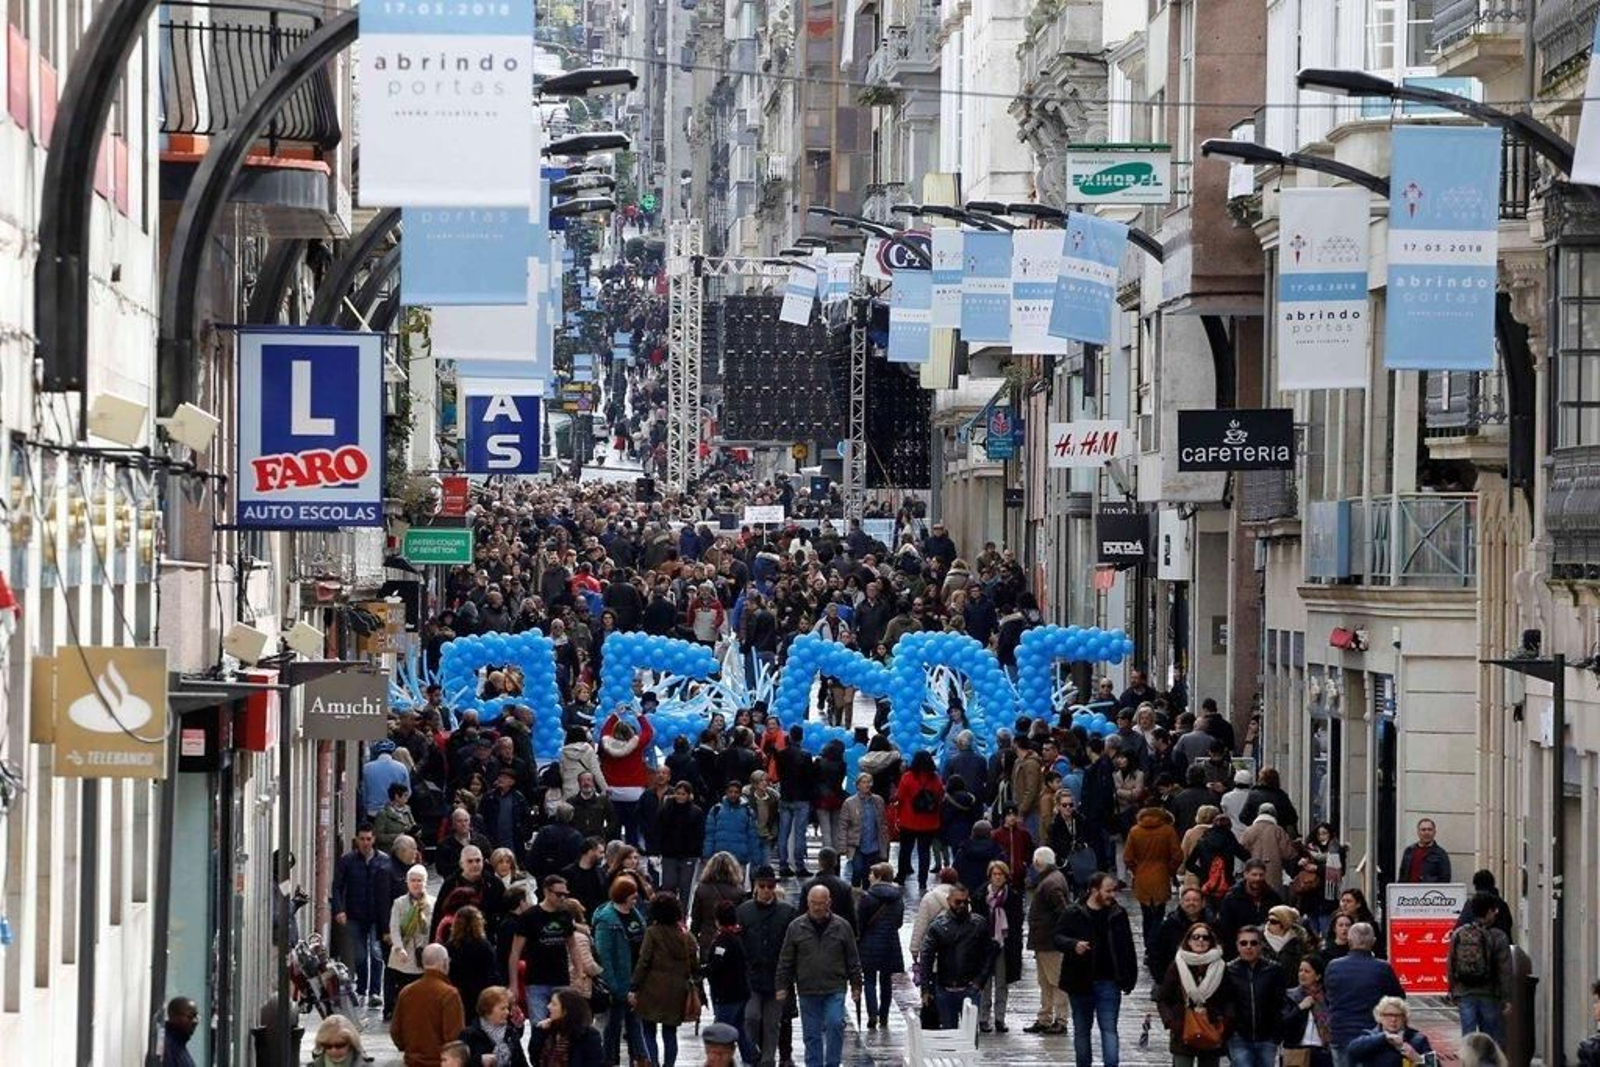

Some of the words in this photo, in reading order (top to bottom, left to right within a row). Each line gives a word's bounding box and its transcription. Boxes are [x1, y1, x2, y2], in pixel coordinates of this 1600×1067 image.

[374, 53, 519, 71] abrindo
[387, 79, 506, 97] portas
[1395, 275, 1488, 288] abrindo
[1402, 292, 1479, 304] portas
[1285, 309, 1361, 321] abrindo
[1292, 322, 1353, 334] portas
[291, 360, 335, 435] L
[1080, 430, 1119, 457] H&M
[251, 447, 369, 492] FARO
[243, 505, 294, 521] AUTO
[300, 506, 376, 521] ESCOLAS
[309, 696, 382, 715] Amichi
